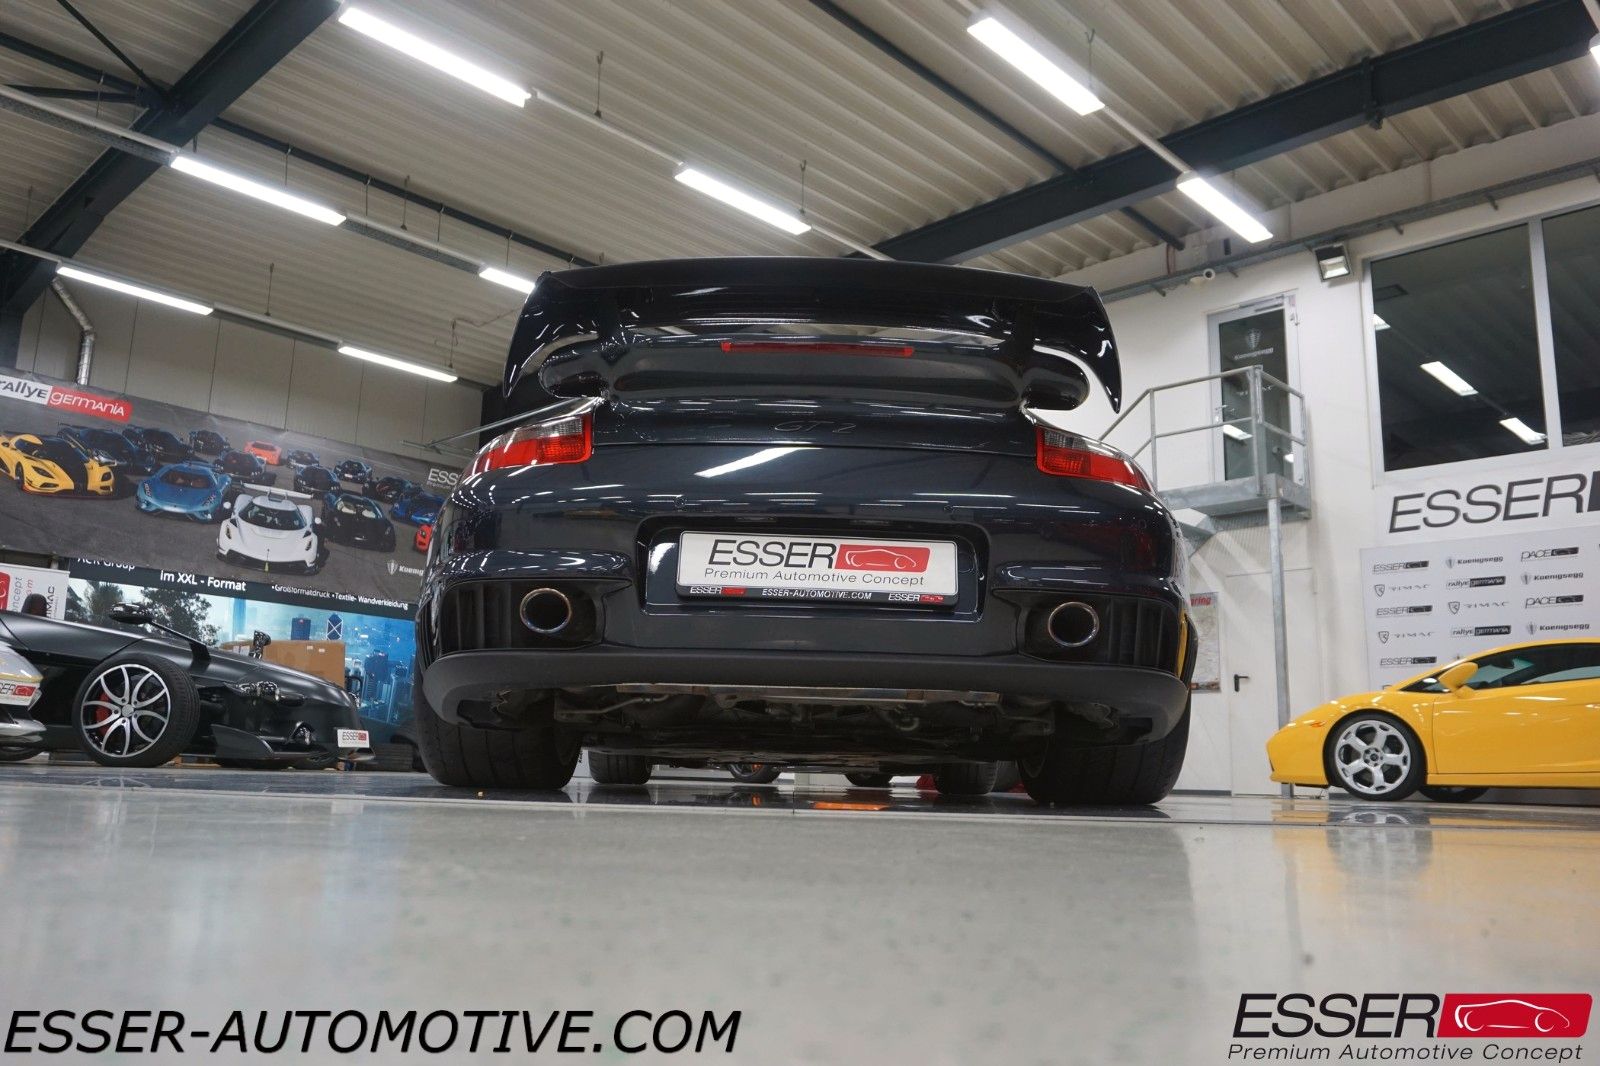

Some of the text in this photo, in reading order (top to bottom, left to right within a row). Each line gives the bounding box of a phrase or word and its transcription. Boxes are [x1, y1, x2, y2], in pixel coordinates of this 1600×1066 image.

[1389, 473, 1588, 534] ESSER
[708, 539, 836, 569] ESSER
[177, 572, 197, 586] XXL
[207, 576, 247, 592] Format
[704, 568, 924, 587] Premium Automotive Concept
[690, 586, 722, 595] ESSER
[762, 588, 872, 600] ESSER-AUTOMOTIVE.COM
[888, 592, 920, 601] ESSER
